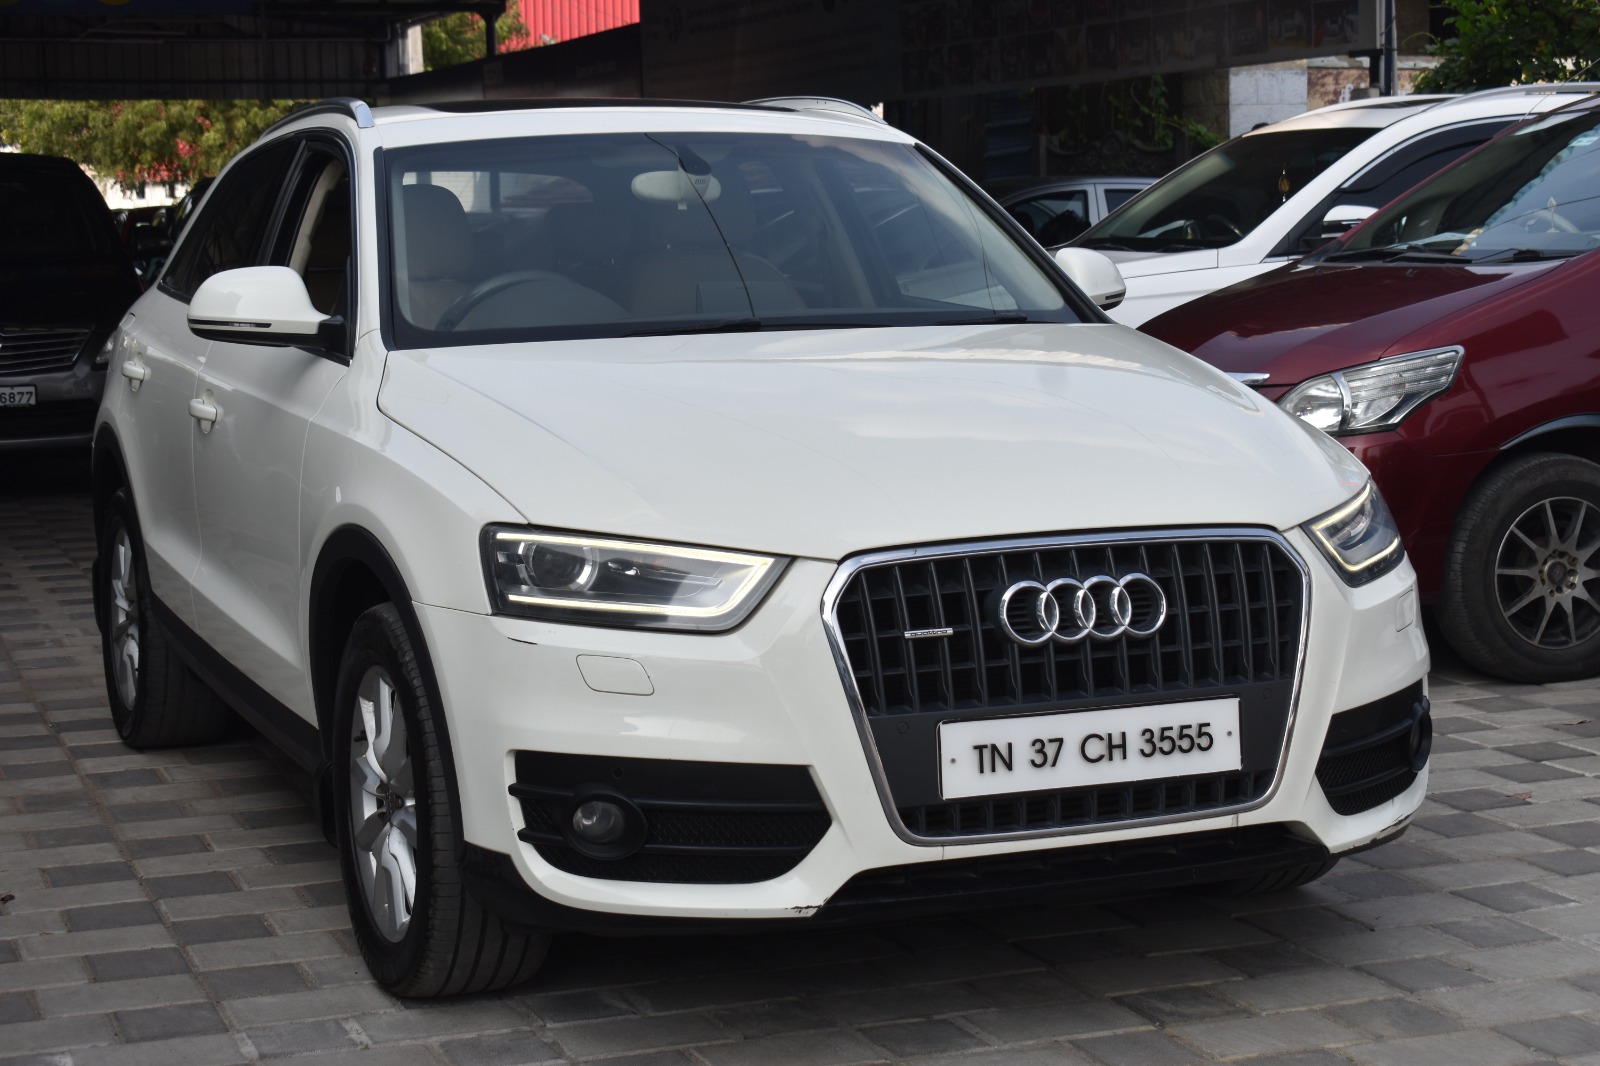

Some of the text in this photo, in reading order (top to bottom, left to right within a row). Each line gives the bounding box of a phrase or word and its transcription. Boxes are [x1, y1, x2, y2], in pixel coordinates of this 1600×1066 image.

[0, 391, 33, 404] 6877
[907, 629, 950, 638] quattro
[973, 722, 1214, 774] TN 37 CH 3555
